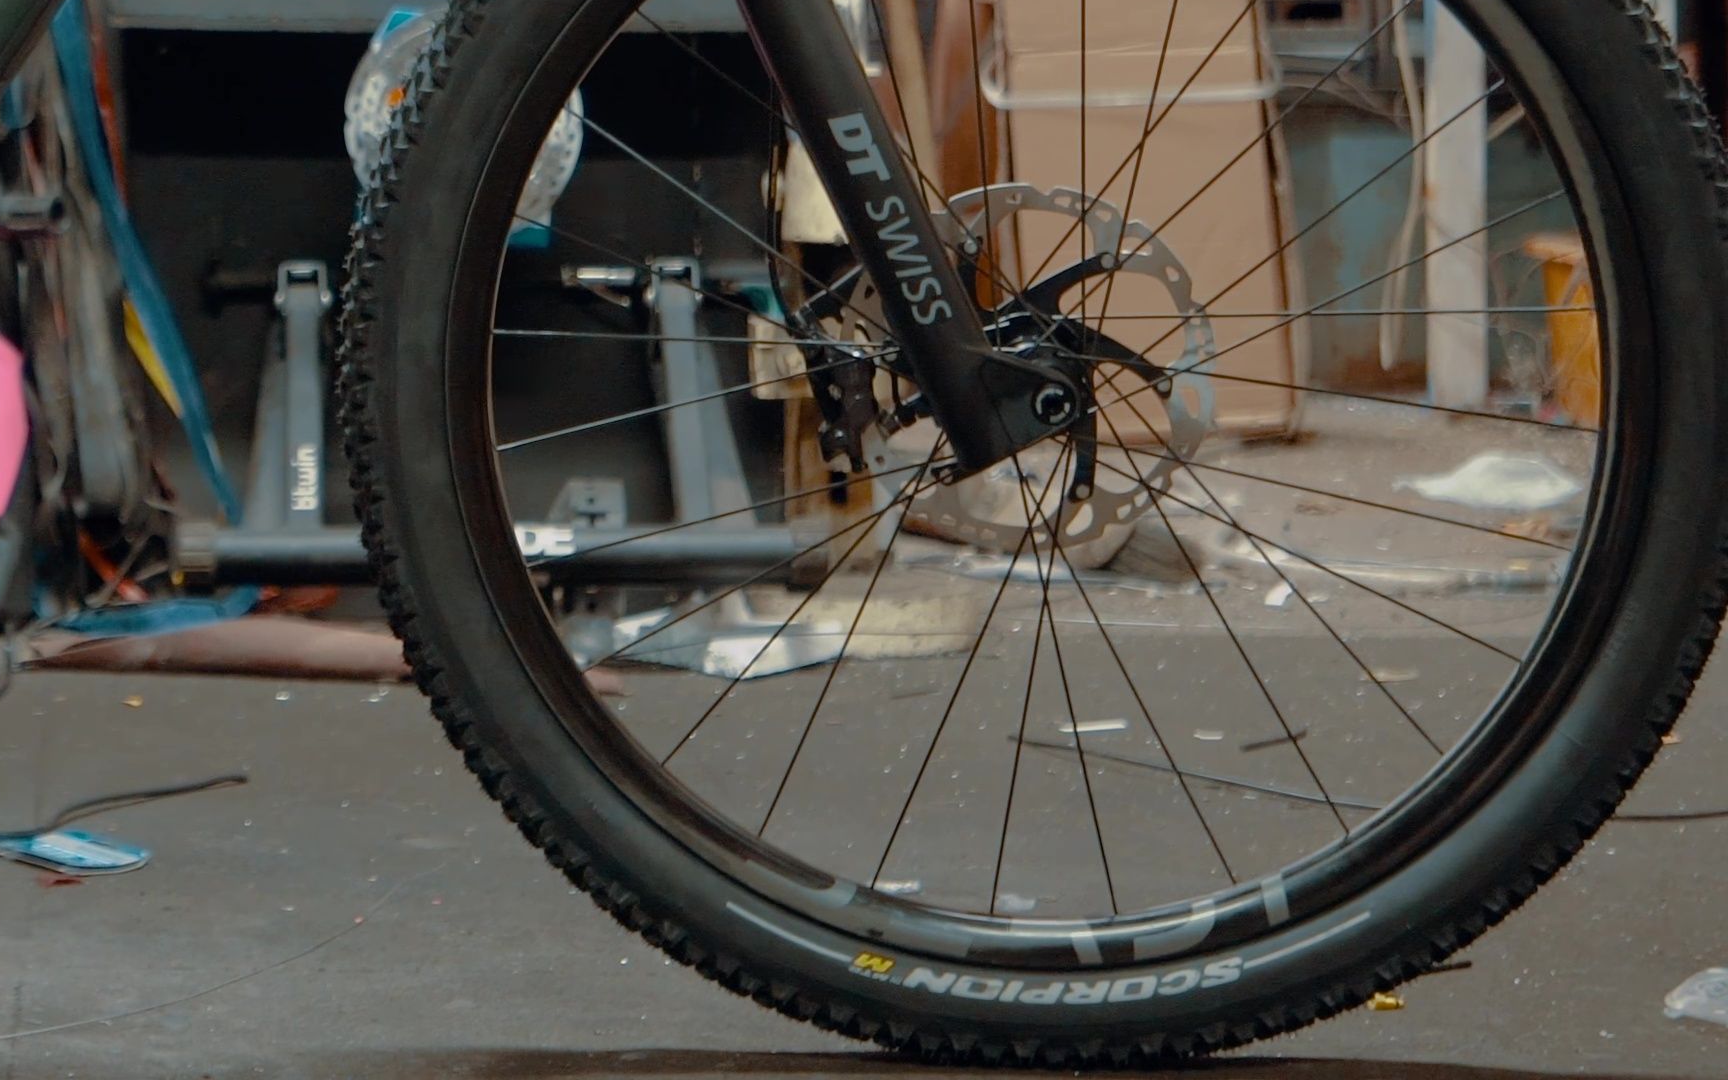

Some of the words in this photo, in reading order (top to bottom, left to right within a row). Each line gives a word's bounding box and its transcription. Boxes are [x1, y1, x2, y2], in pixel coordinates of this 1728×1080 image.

[827, 112, 891, 182] DT
[864, 195, 953, 326] SWISS
[901, 955, 1246, 1005] SCORPION
